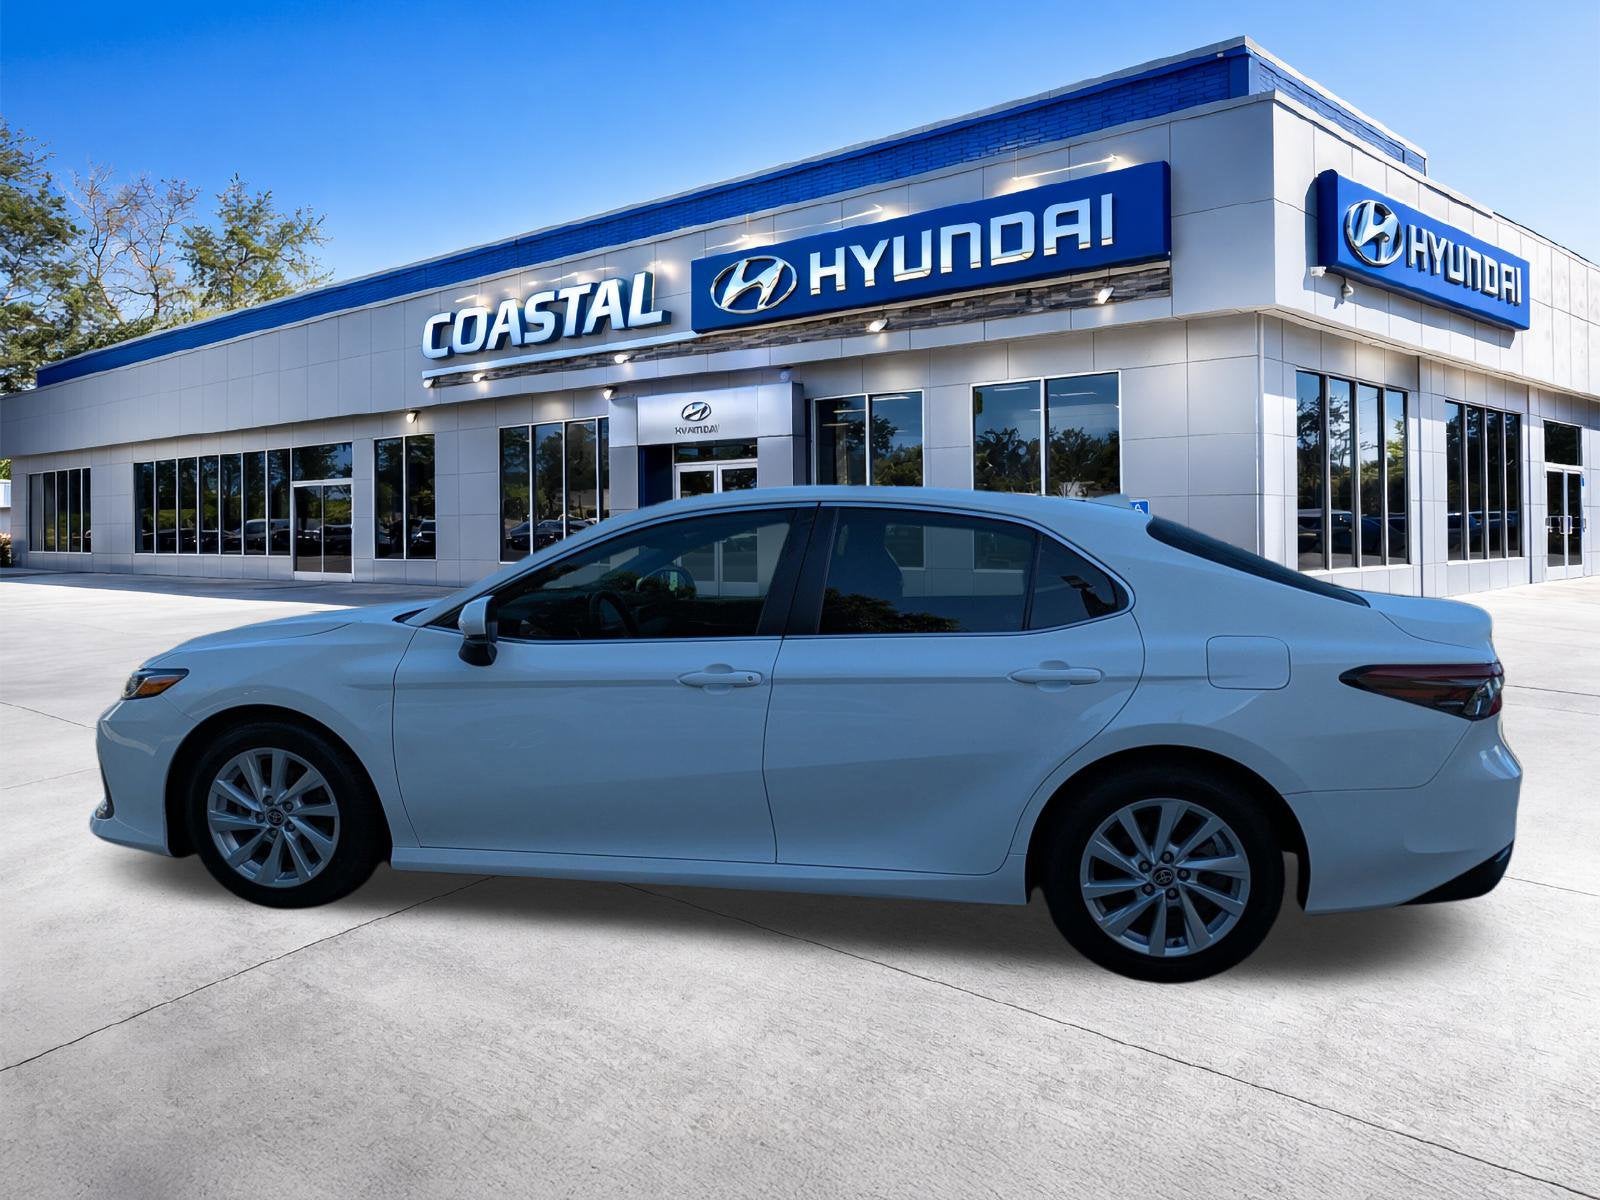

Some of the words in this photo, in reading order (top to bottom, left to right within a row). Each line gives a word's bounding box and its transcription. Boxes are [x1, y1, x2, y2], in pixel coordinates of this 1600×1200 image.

[809, 193, 1114, 296] HYUNDAI
[1406, 224, 1522, 306] HYUNDAI
[422, 271, 669, 359] COASTAL
